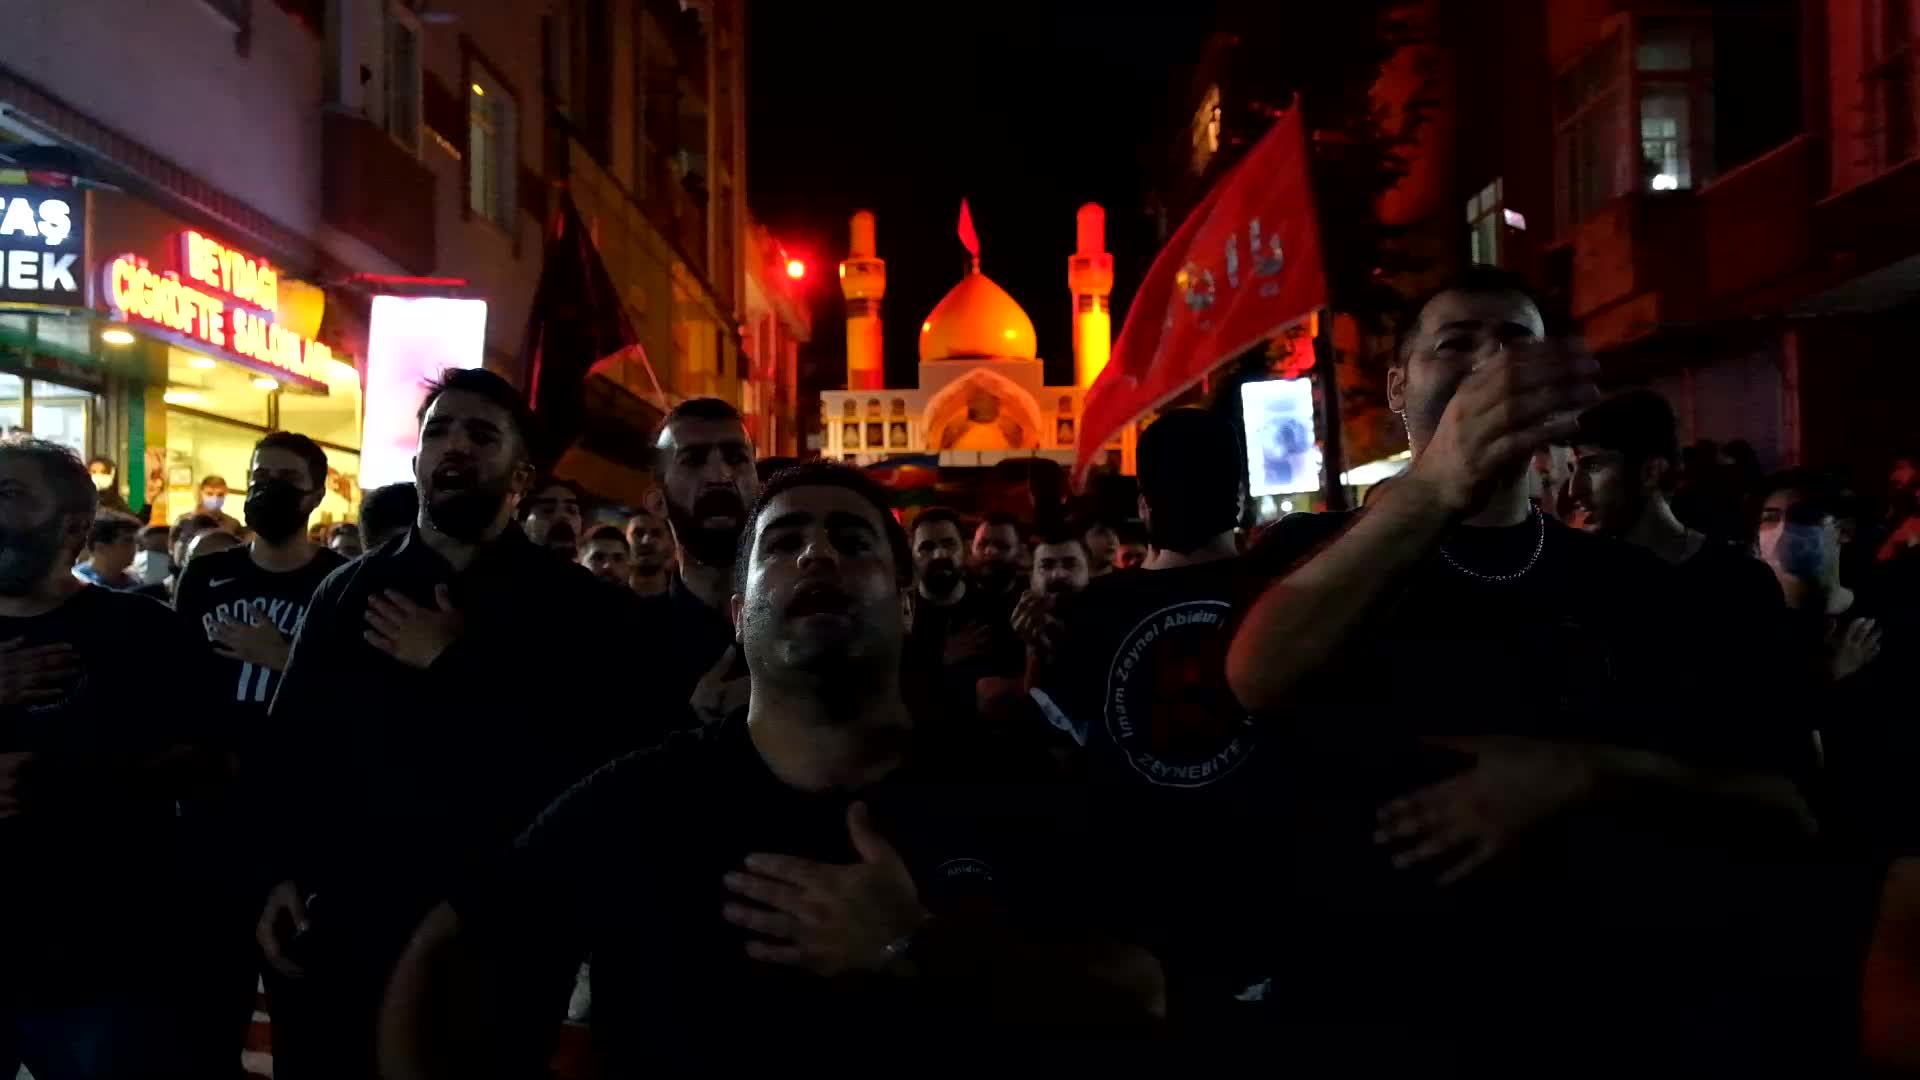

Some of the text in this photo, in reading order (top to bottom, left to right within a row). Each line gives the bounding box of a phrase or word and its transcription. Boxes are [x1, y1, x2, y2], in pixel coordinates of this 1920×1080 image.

[0, 197, 71, 246] AŞ
[0, 249, 78, 292] EK
[202, 596, 305, 642] BROOKLY
[237, 660, 271, 702] 11
